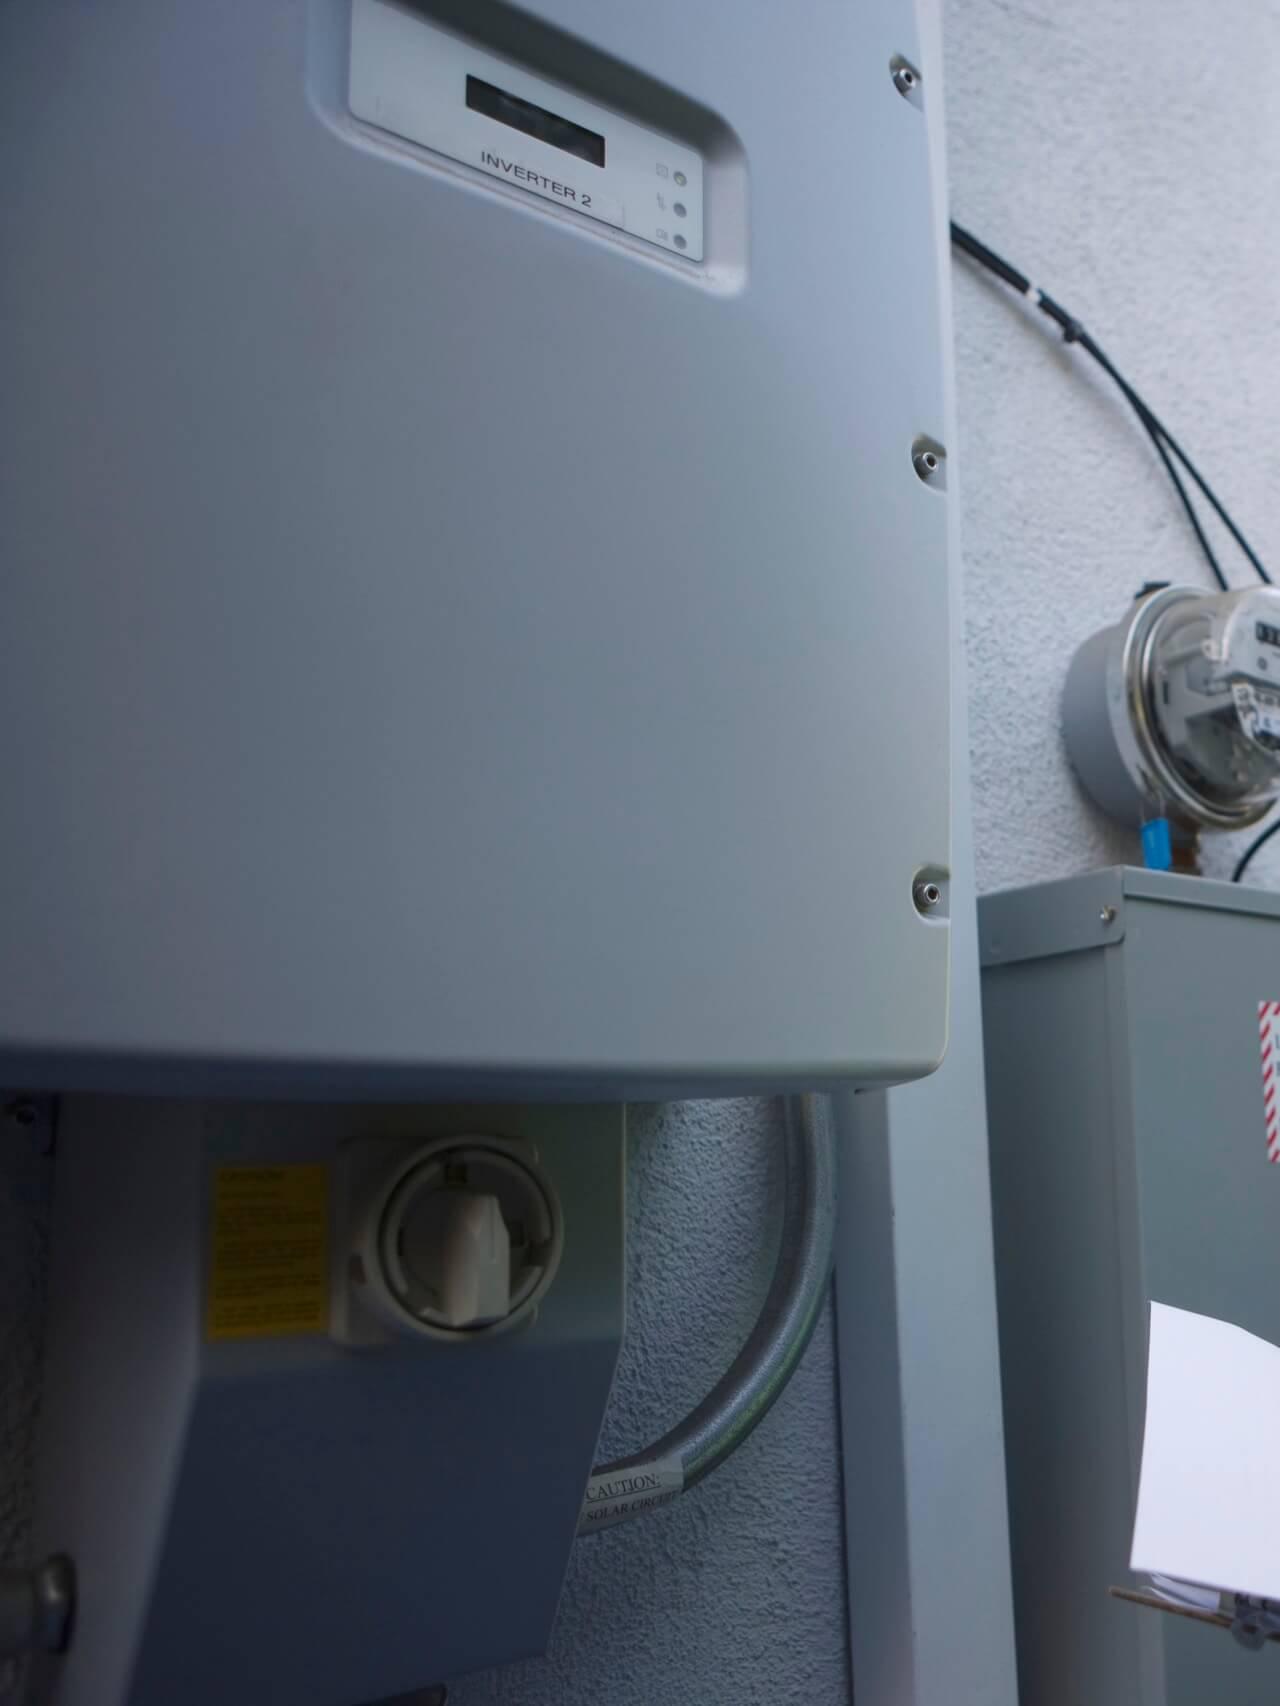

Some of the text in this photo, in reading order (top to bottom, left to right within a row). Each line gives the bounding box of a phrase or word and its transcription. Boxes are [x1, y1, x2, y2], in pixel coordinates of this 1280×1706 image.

[480, 150, 593, 208] INVERTER 2
[585, 1473, 661, 1501] CAUTION:
[586, 1503, 629, 1521] SOLAR
